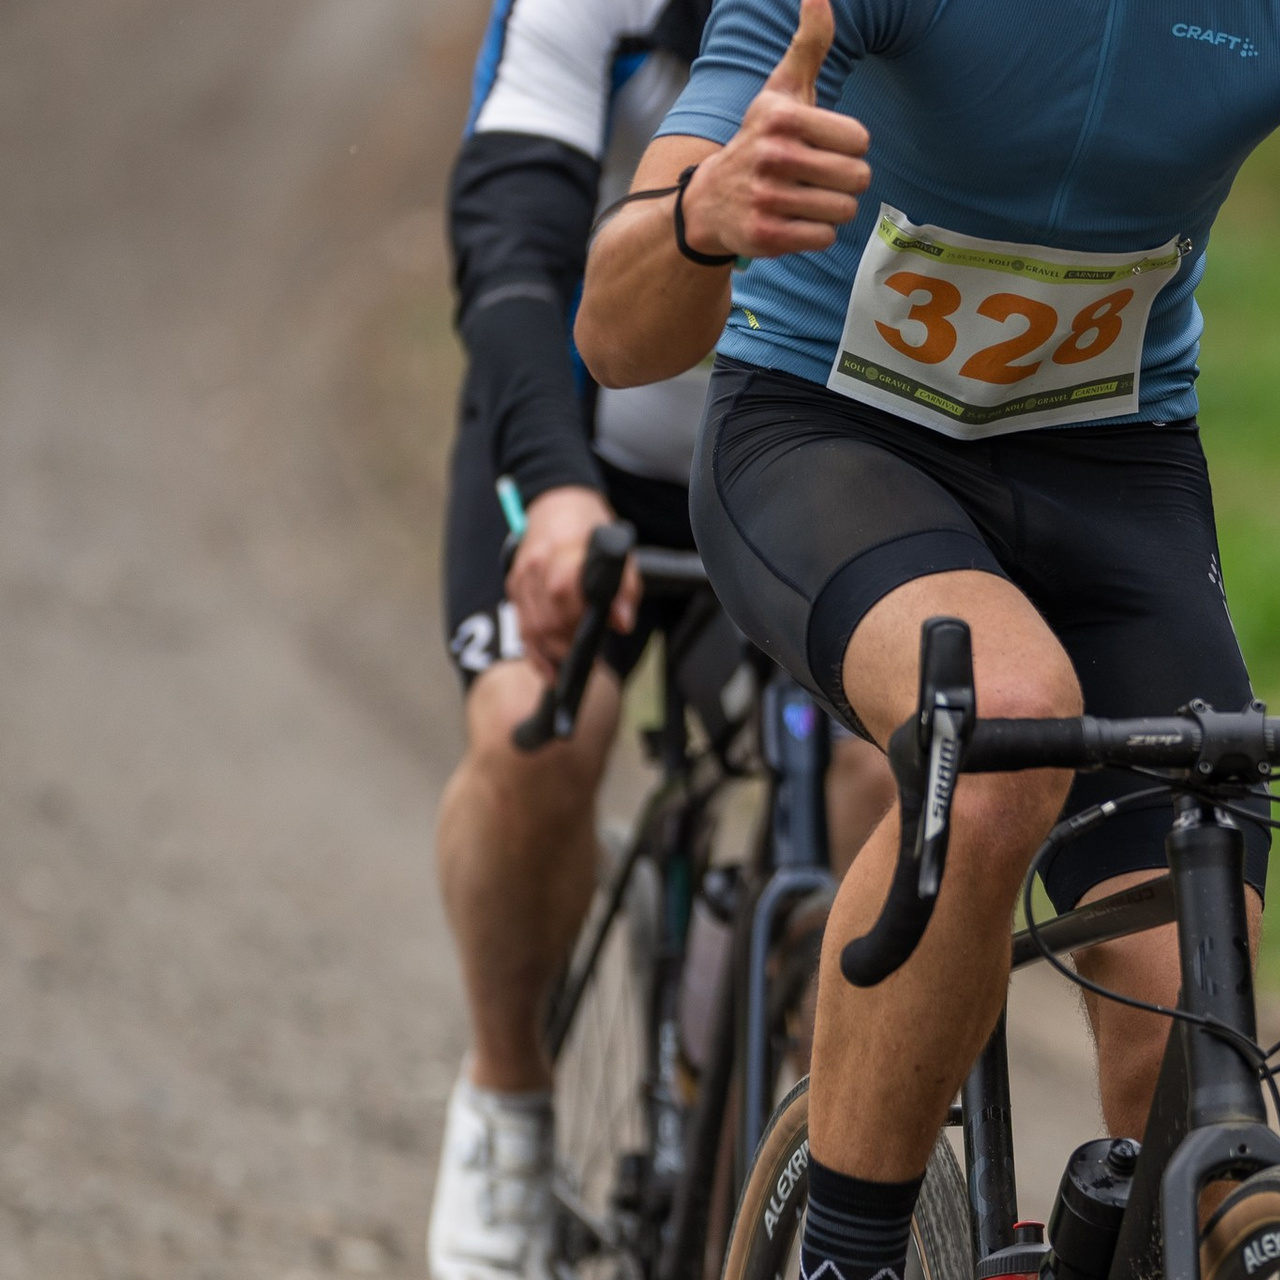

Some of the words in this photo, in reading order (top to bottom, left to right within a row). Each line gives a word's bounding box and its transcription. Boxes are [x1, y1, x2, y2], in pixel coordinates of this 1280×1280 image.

[1171, 23, 1241, 50] CRAFT
[988, 258, 1011, 267] KOLI
[1025, 264, 1060, 278] GRAVEL
[1068, 271, 1112, 279] CARNIVAL
[874, 271, 1134, 384] 328
[843, 359, 866, 373] KOLI
[879, 374, 912, 393] GRAVEL
[919, 390, 960, 414] CARNIVAL
[1005, 402, 1024, 413] KOLI
[1037, 394, 1069, 406] GRAVEL
[1075, 383, 1115, 397] CARNIVAL
[932, 738, 957, 819] SRAM
[764, 1138, 810, 1241] ALEXRI
